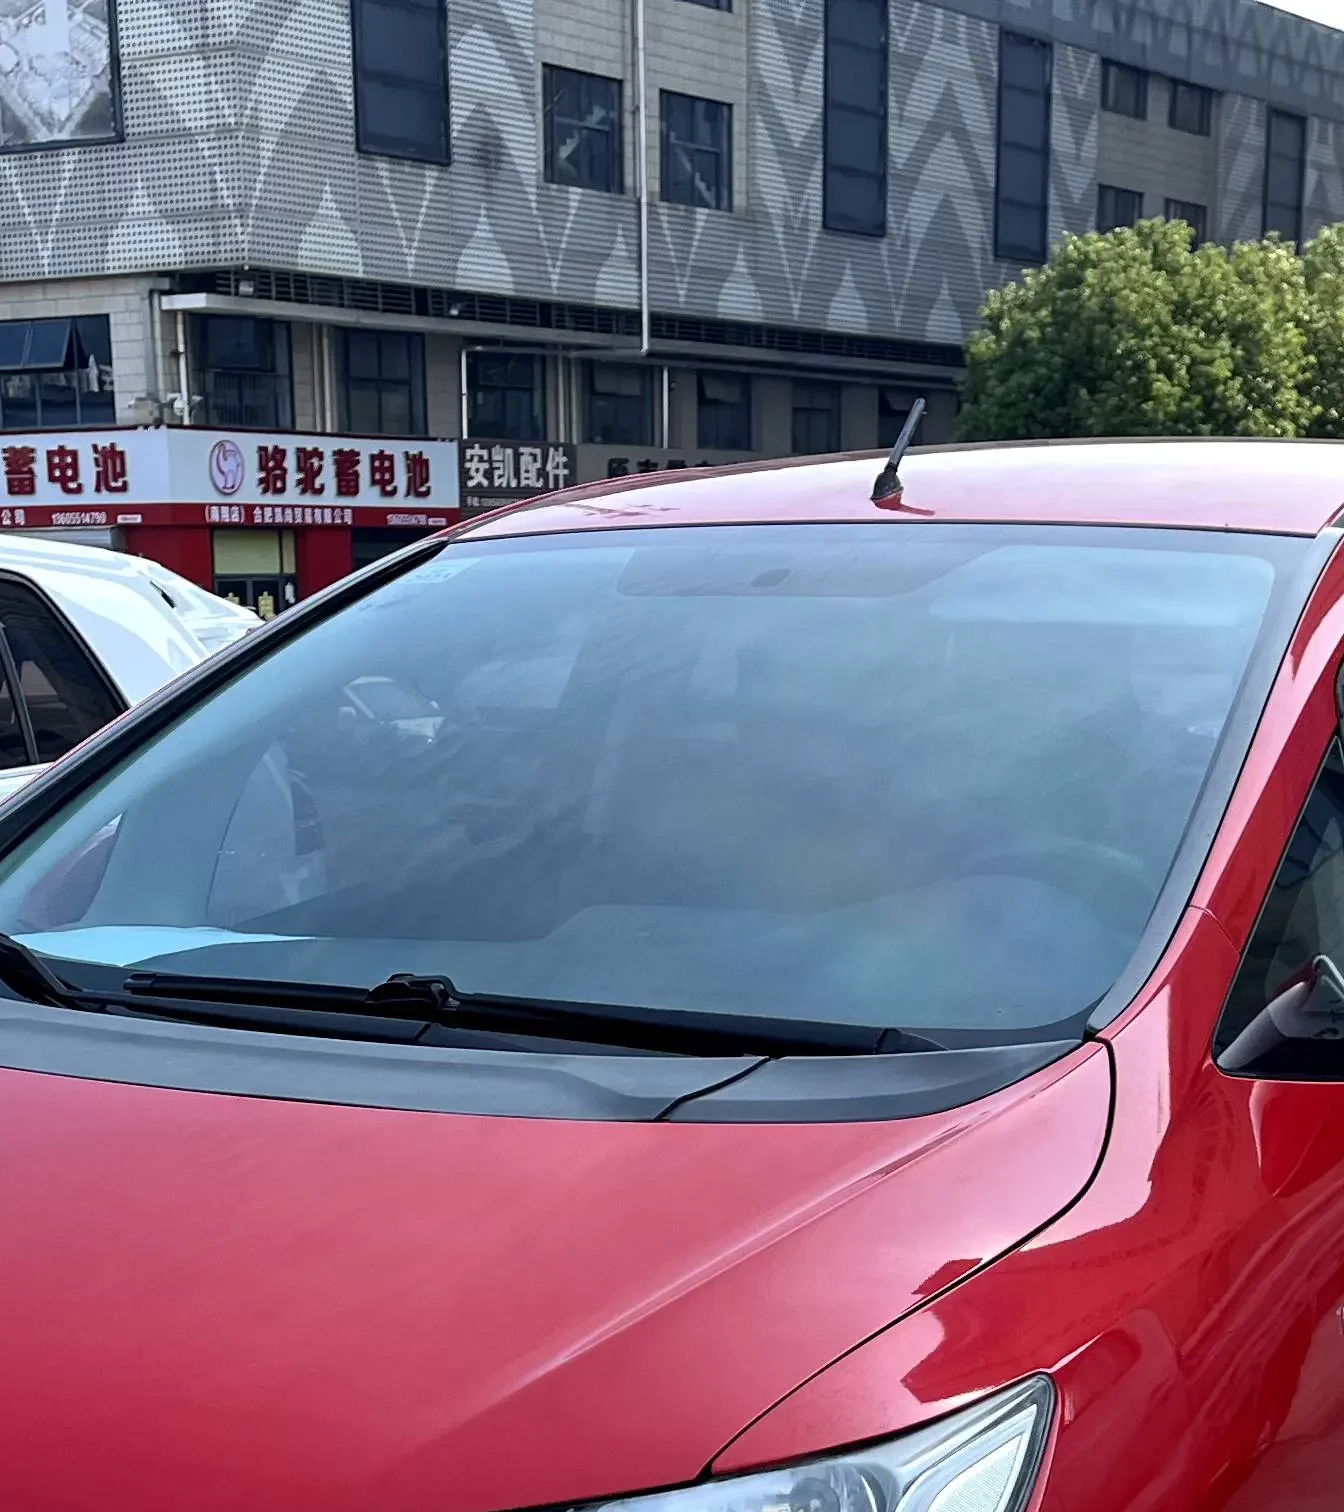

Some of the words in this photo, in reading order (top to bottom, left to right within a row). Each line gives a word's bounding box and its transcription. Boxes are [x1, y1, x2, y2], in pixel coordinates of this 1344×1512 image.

[256, 445, 431, 498] 骆驼蓄电池
[463, 443, 570, 489] 安凯配件
